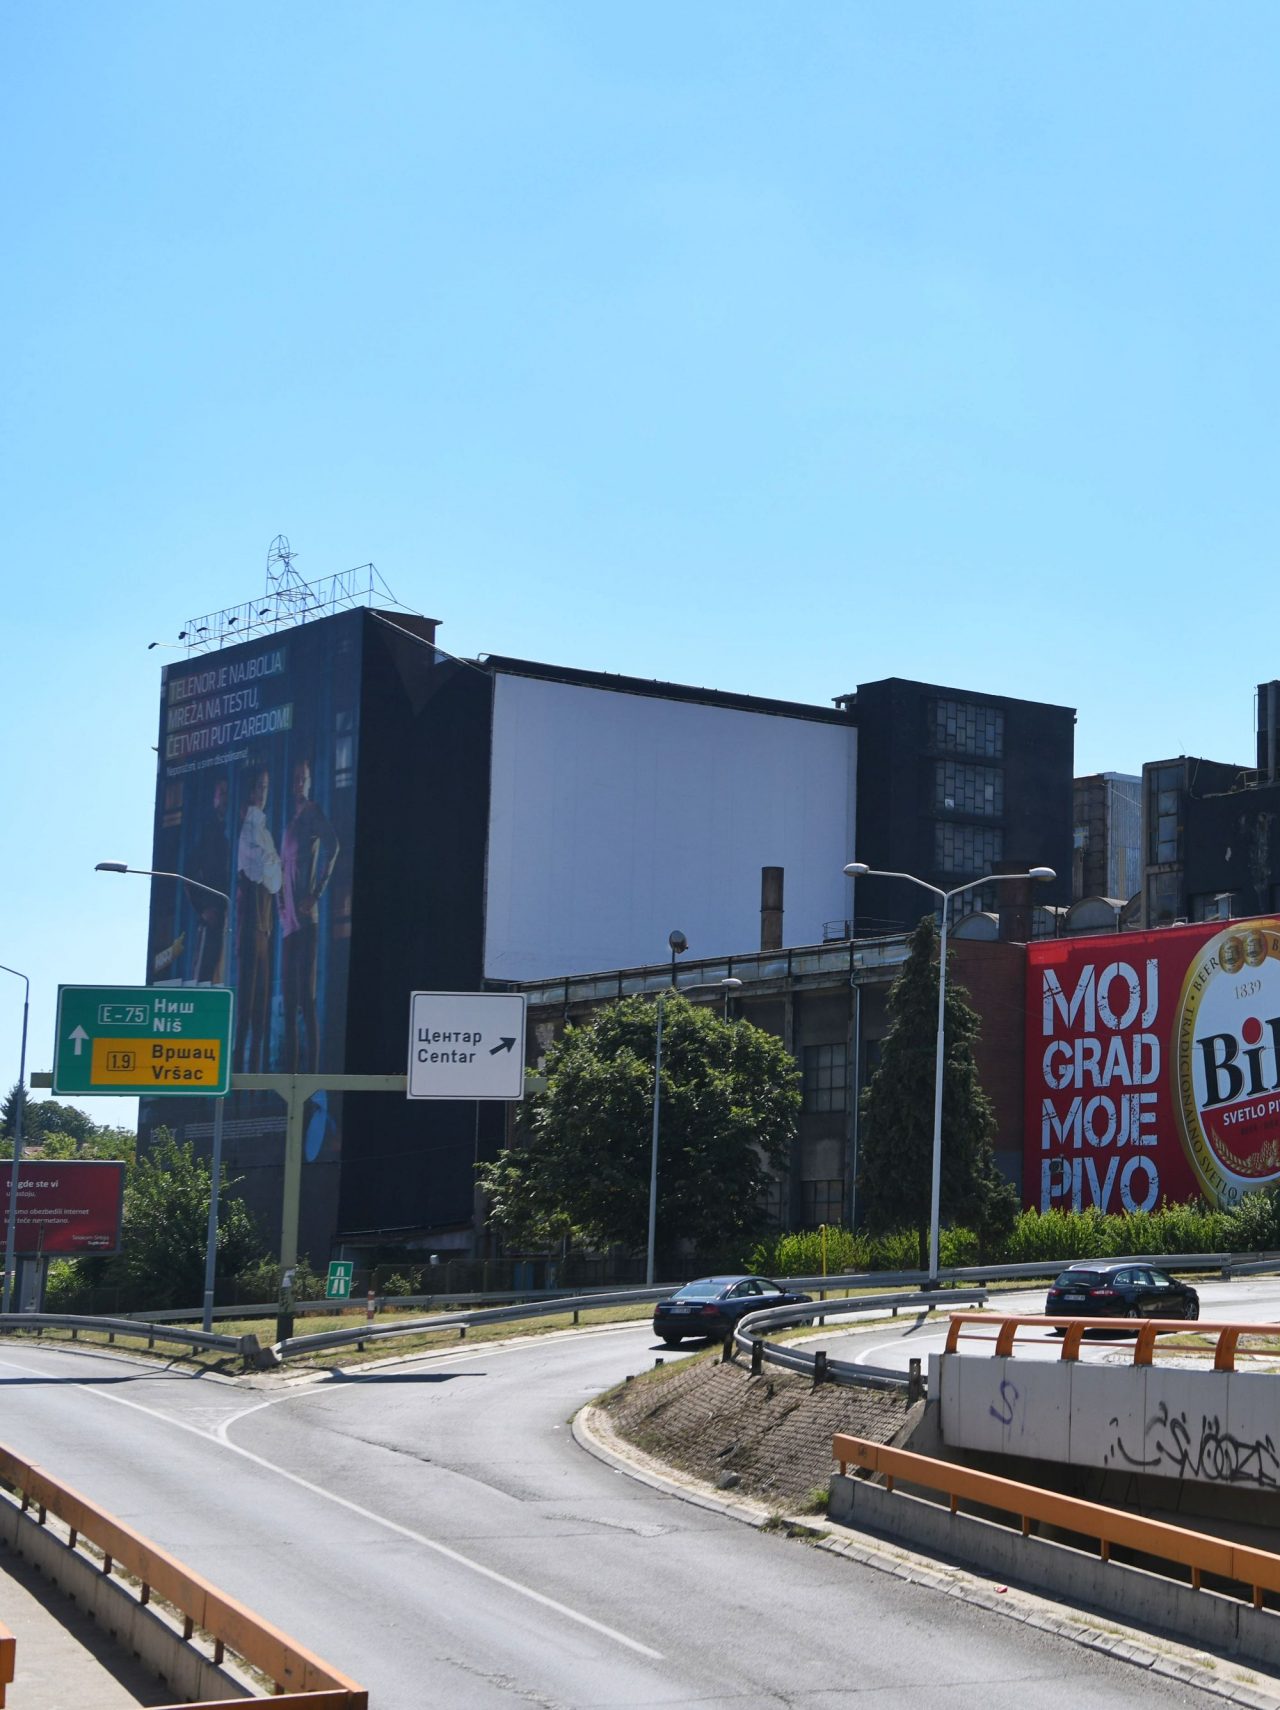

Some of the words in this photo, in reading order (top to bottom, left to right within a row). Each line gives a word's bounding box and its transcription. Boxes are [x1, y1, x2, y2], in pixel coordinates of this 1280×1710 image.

[170, 670, 216, 700] TELENOR
[230, 651, 282, 684] NAJBOLJA
[168, 701, 203, 730] MREŽA
[205, 700, 221, 719] NA
[211, 722, 232, 745] PUT
[1193, 956, 1219, 992] BEER
[1042, 958, 1159, 1036] MOJ
[1235, 979, 1262, 999] 1839
[103, 1007, 144, 1022] E-75
[154, 998, 194, 1014] Ниш
[153, 1018, 182, 1032] Niš
[418, 1028, 482, 1046] Центар
[152, 1044, 215, 1062] Вршац
[417, 1048, 476, 1063] Centar
[1042, 1033, 1161, 1089] GRAD
[152, 1065, 203, 1080] Vršac
[1179, 1006, 1204, 1153] TRADICIONALNO
[1200, 1157, 1238, 1200] SVETLO
[1041, 1092, 1158, 1149] MOJE
[1223, 1104, 1266, 1126] SVETLO
[17, 1180, 34, 1190] gde
[35, 1180, 49, 1188] ste
[1040, 1155, 1160, 1215] PIVO
